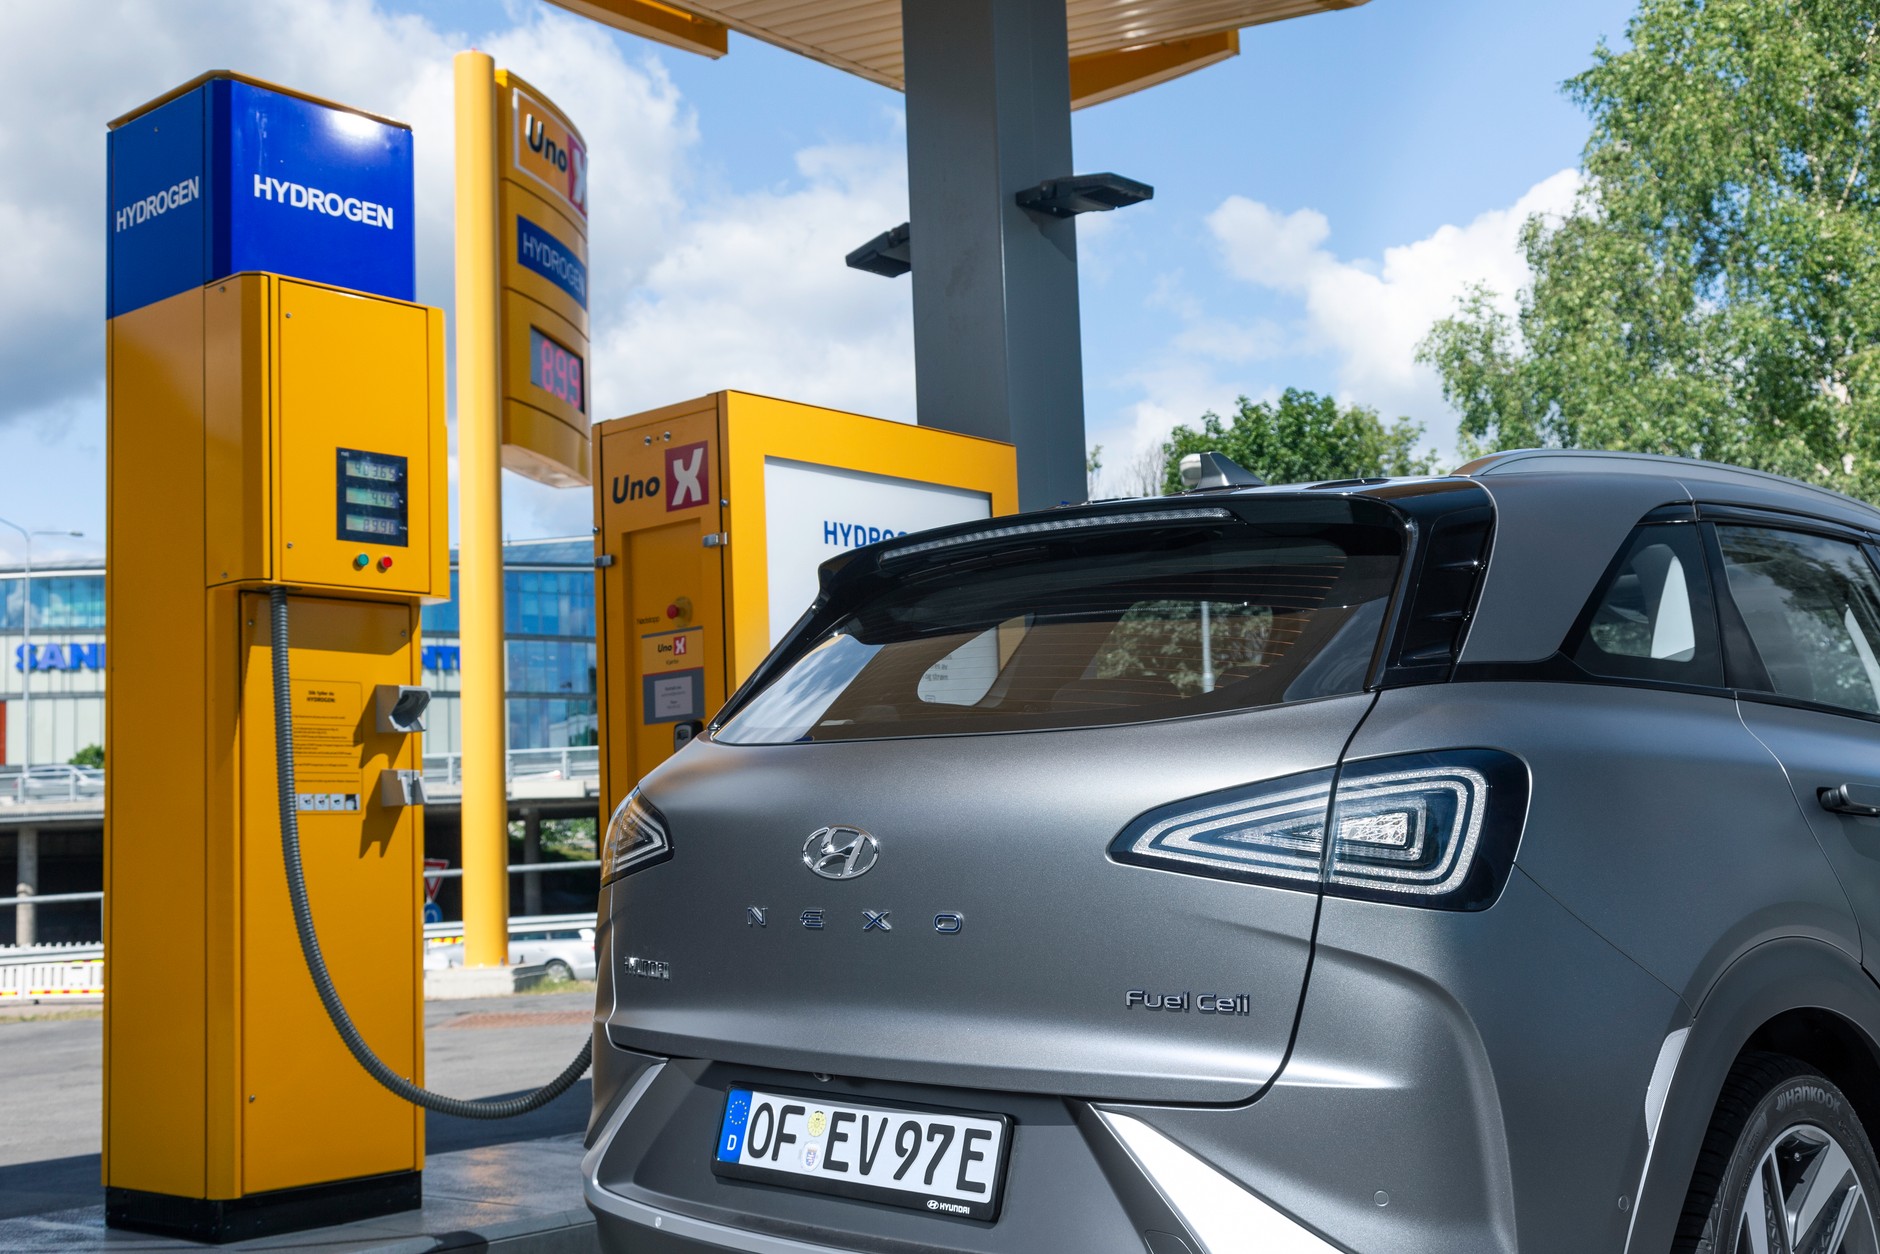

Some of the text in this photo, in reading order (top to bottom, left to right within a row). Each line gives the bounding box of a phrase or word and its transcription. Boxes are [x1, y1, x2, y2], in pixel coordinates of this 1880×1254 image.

[525, 113, 567, 173] Uno
[116, 175, 199, 232] HYDROGEN
[253, 173, 394, 230] HYDROGEN
[523, 232, 585, 297] HYDROGEN
[612, 447, 704, 506] Uno X
[823, 520, 907, 548] HYDR
[16, 642, 106, 671] SAN
[657, 637, 685, 654] Uno X
[747, 907, 964, 933] NEXO
[1125, 989, 1250, 1014] Fuel Cell
[727, 1134, 738, 1151] D
[747, 1102, 806, 1161] OF
[940, 1202, 970, 1214] HYUNDAI
